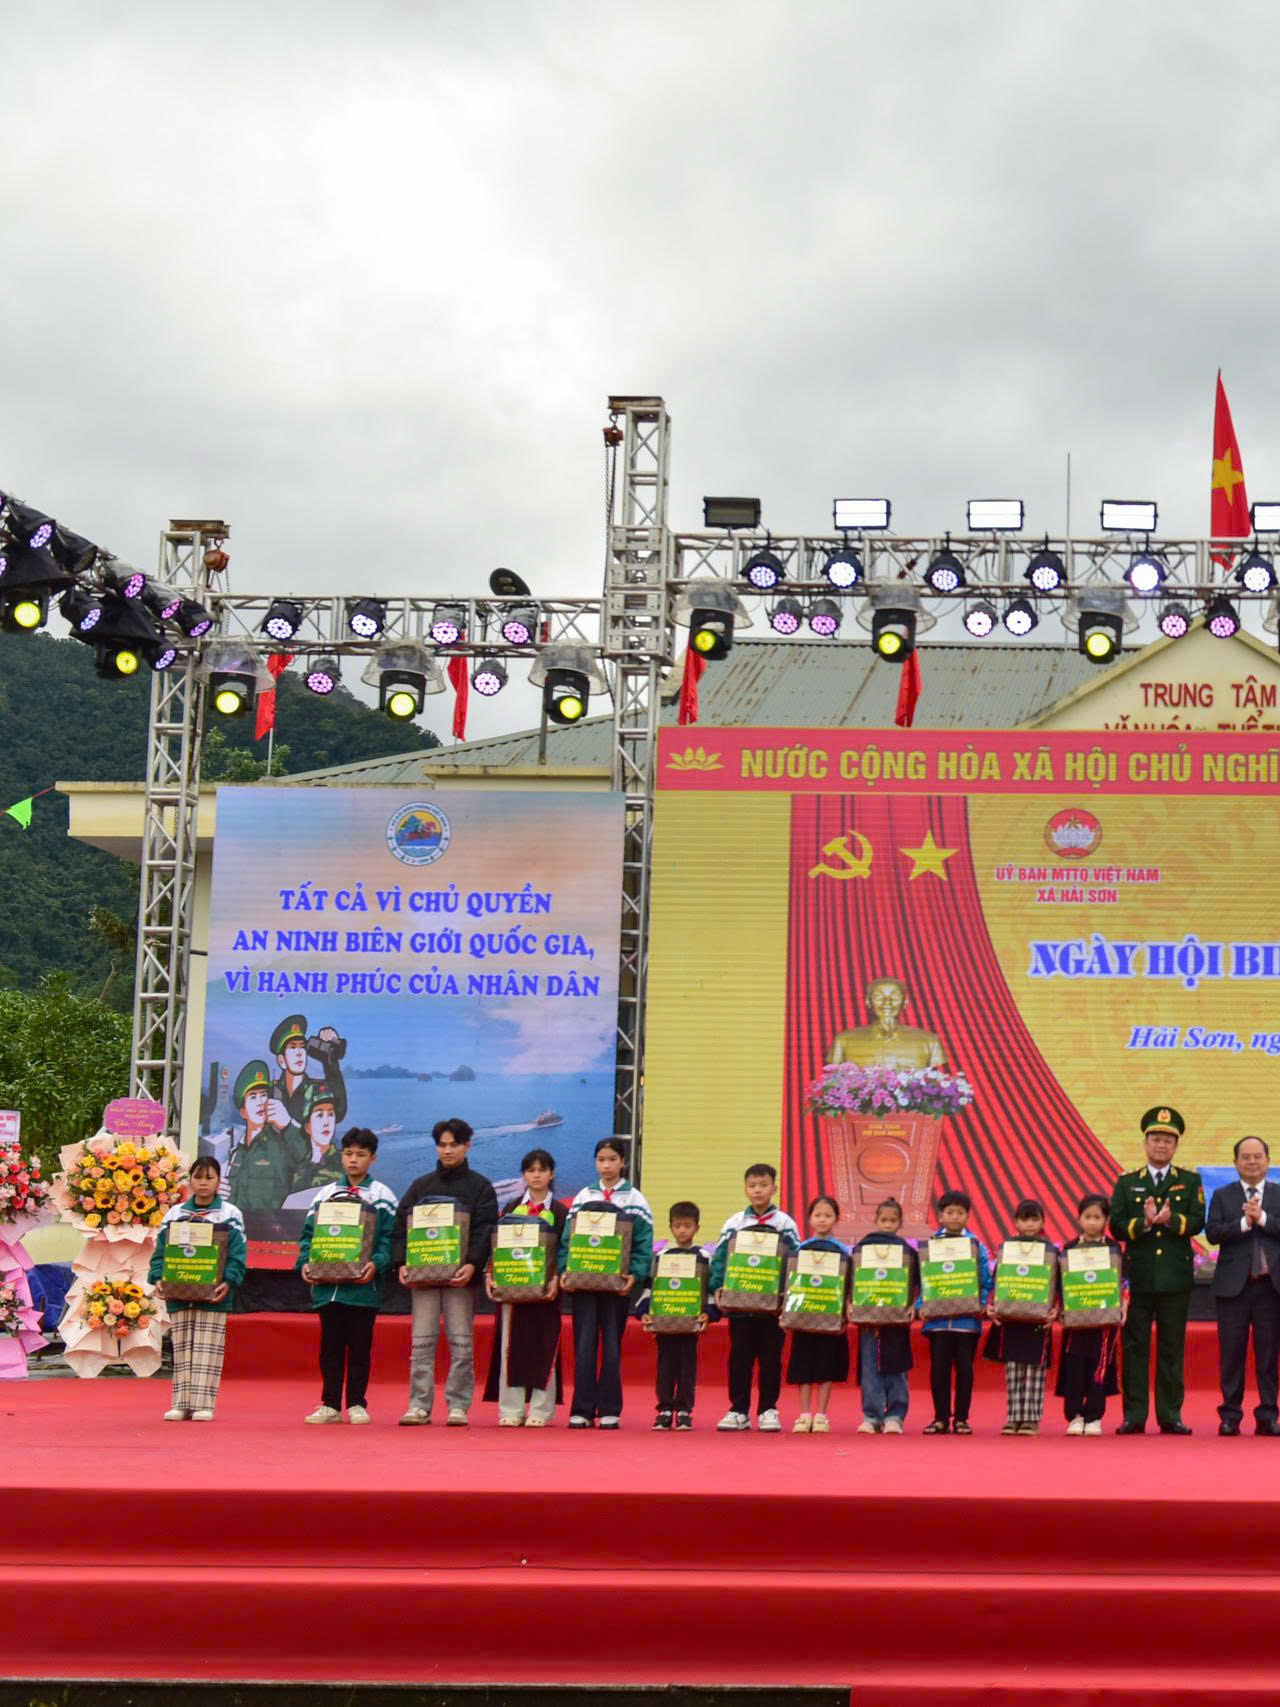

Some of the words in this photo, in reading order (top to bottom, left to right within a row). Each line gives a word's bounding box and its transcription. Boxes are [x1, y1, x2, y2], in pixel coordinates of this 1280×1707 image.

[1140, 683, 1213, 707] TRUNG
[1232, 675, 1277, 707] TÂM
[740, 744, 828, 779] NƯỚC
[839, 745, 926, 786] CỘNG
[937, 745, 1001, 781] HÒA
[1012, 747, 1054, 782] XÃ
[1064, 747, 1117, 788] HỘI
[1128, 744, 1192, 782] CHỦ
[1019, 868, 1047, 881] BAN
[1052, 868, 1088, 882] MTTQ
[1094, 866, 1122, 883] VIỆT
[1127, 868, 1159, 881] NAM
[279, 881, 328, 910] TẤT
[335, 882, 368, 911] CẢ
[376, 886, 401, 911] VÌ
[408, 884, 459, 912] CHỦ
[467, 883, 552, 917] QUYỀN
[1088, 889, 1117, 902] SƠN
[232, 930, 268, 951] AN
[276, 931, 338, 952] NINH
[345, 926, 402, 952] BIÊN
[410, 927, 462, 953] GIỚI
[469, 925, 537, 959] QUỐC
[544, 934, 595, 960] GIA,
[1032, 935, 1137, 976] NGÀY
[1149, 937, 1221, 987] HỘI
[224, 966, 250, 992] VÌ
[257, 972, 328, 998] HẠNH
[336, 968, 401, 993] PHÚC
[408, 965, 459, 994] CỦA
[467, 969, 539, 995] NHÂN
[546, 970, 600, 997] DÂN
[1129, 1027, 1177, 1048] Hải
[1184, 1027, 1244, 1051] Sơn,
